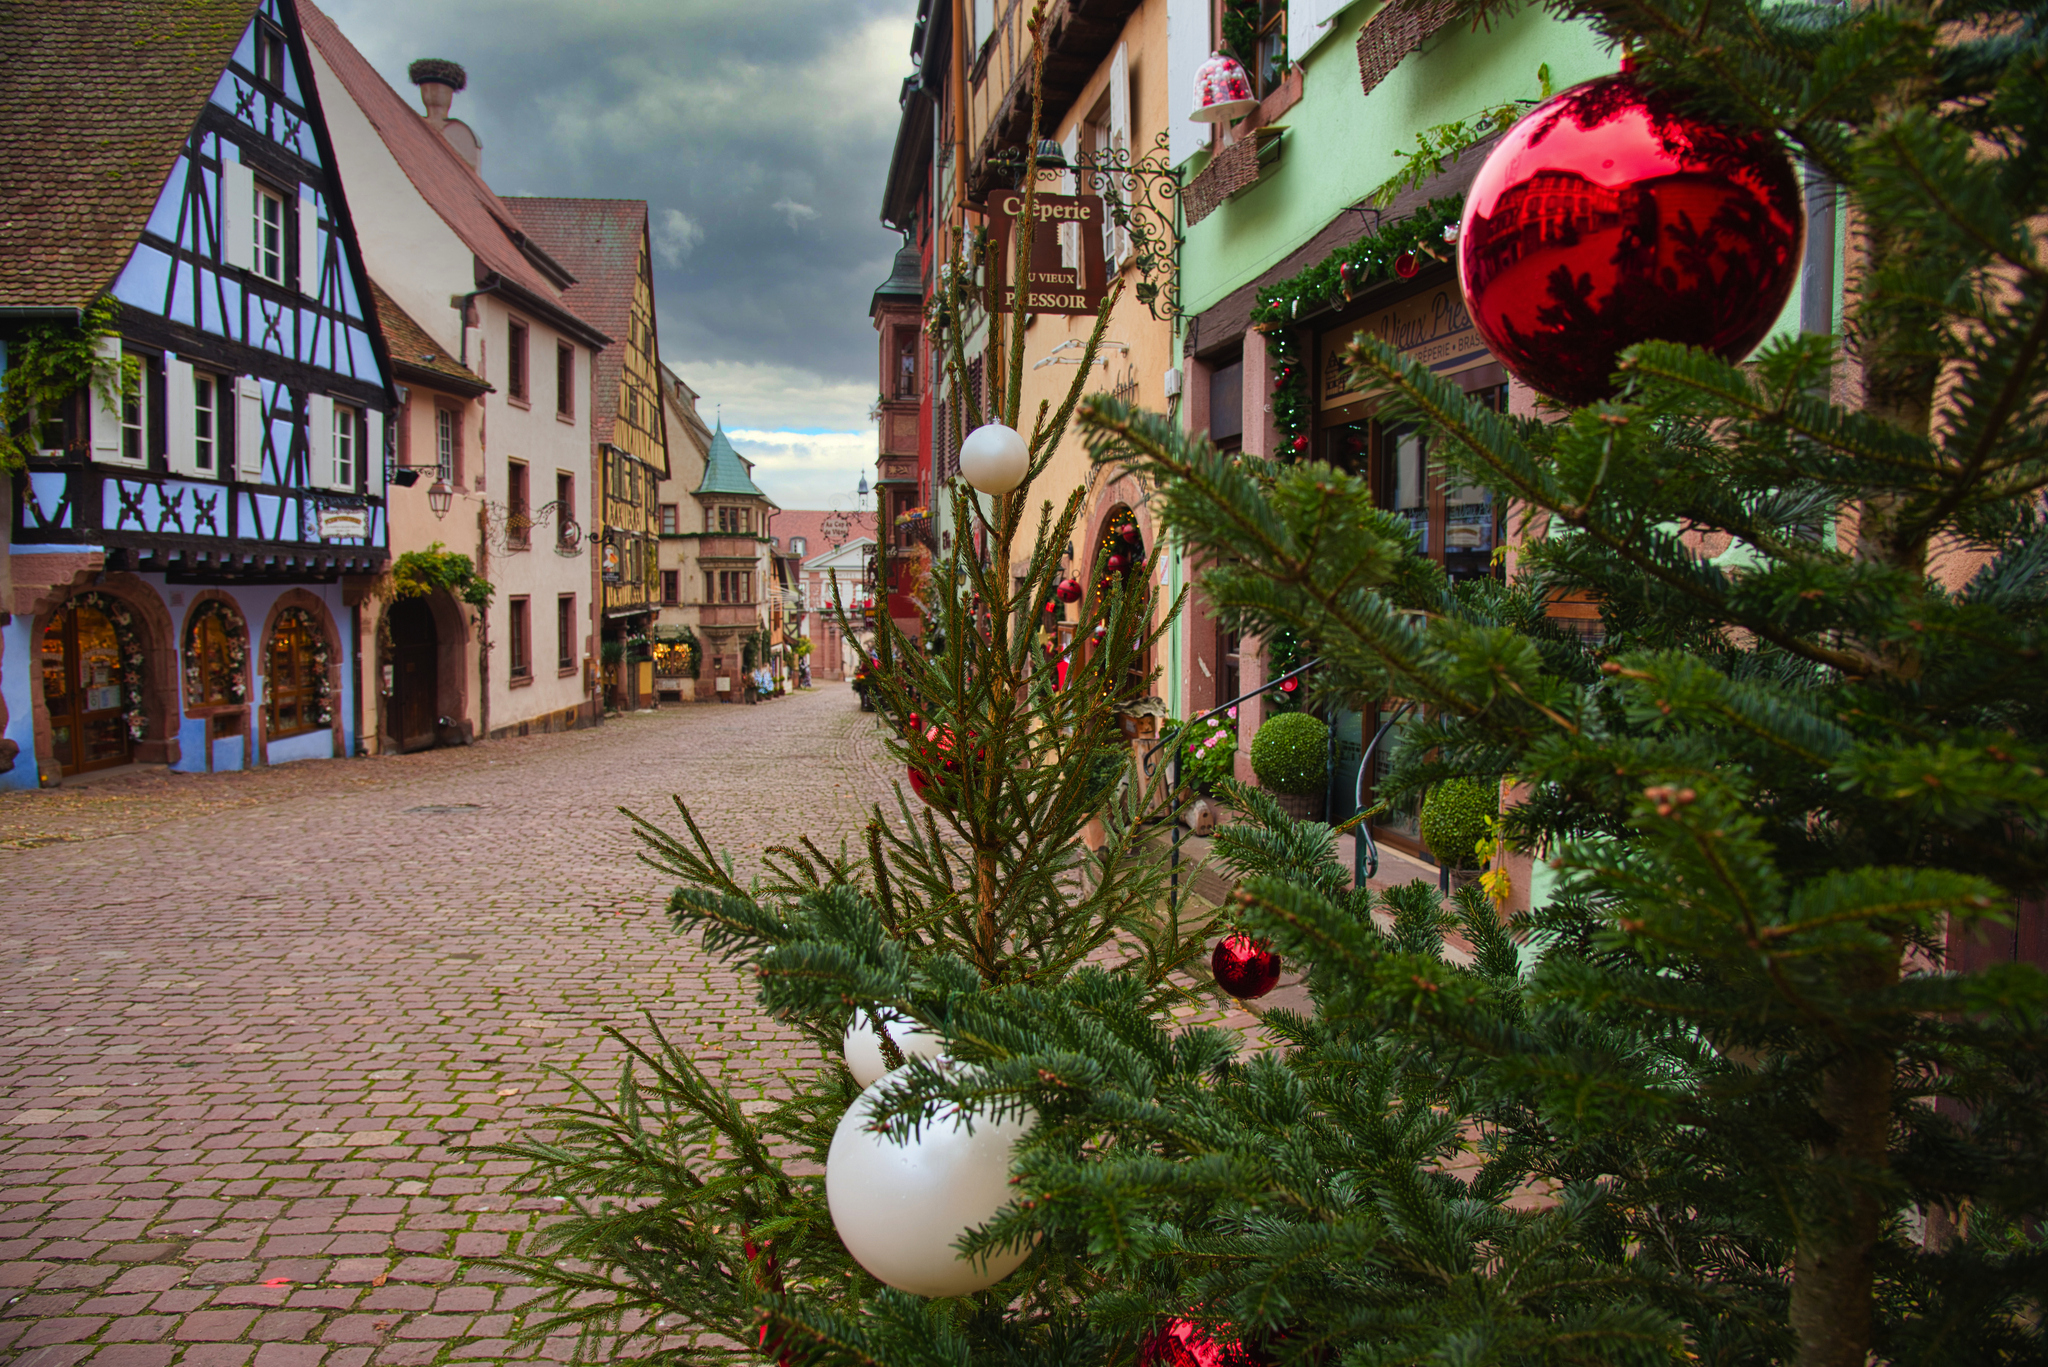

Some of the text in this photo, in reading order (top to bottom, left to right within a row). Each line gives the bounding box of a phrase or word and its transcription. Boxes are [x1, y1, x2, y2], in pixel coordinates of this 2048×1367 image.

[1039, 273, 1075, 284] VIEUX
[1005, 292, 1087, 309] PESSOIR
[1381, 291, 1472, 349] Vieux Pres
[1458, 333, 1484, 352] BRAS
